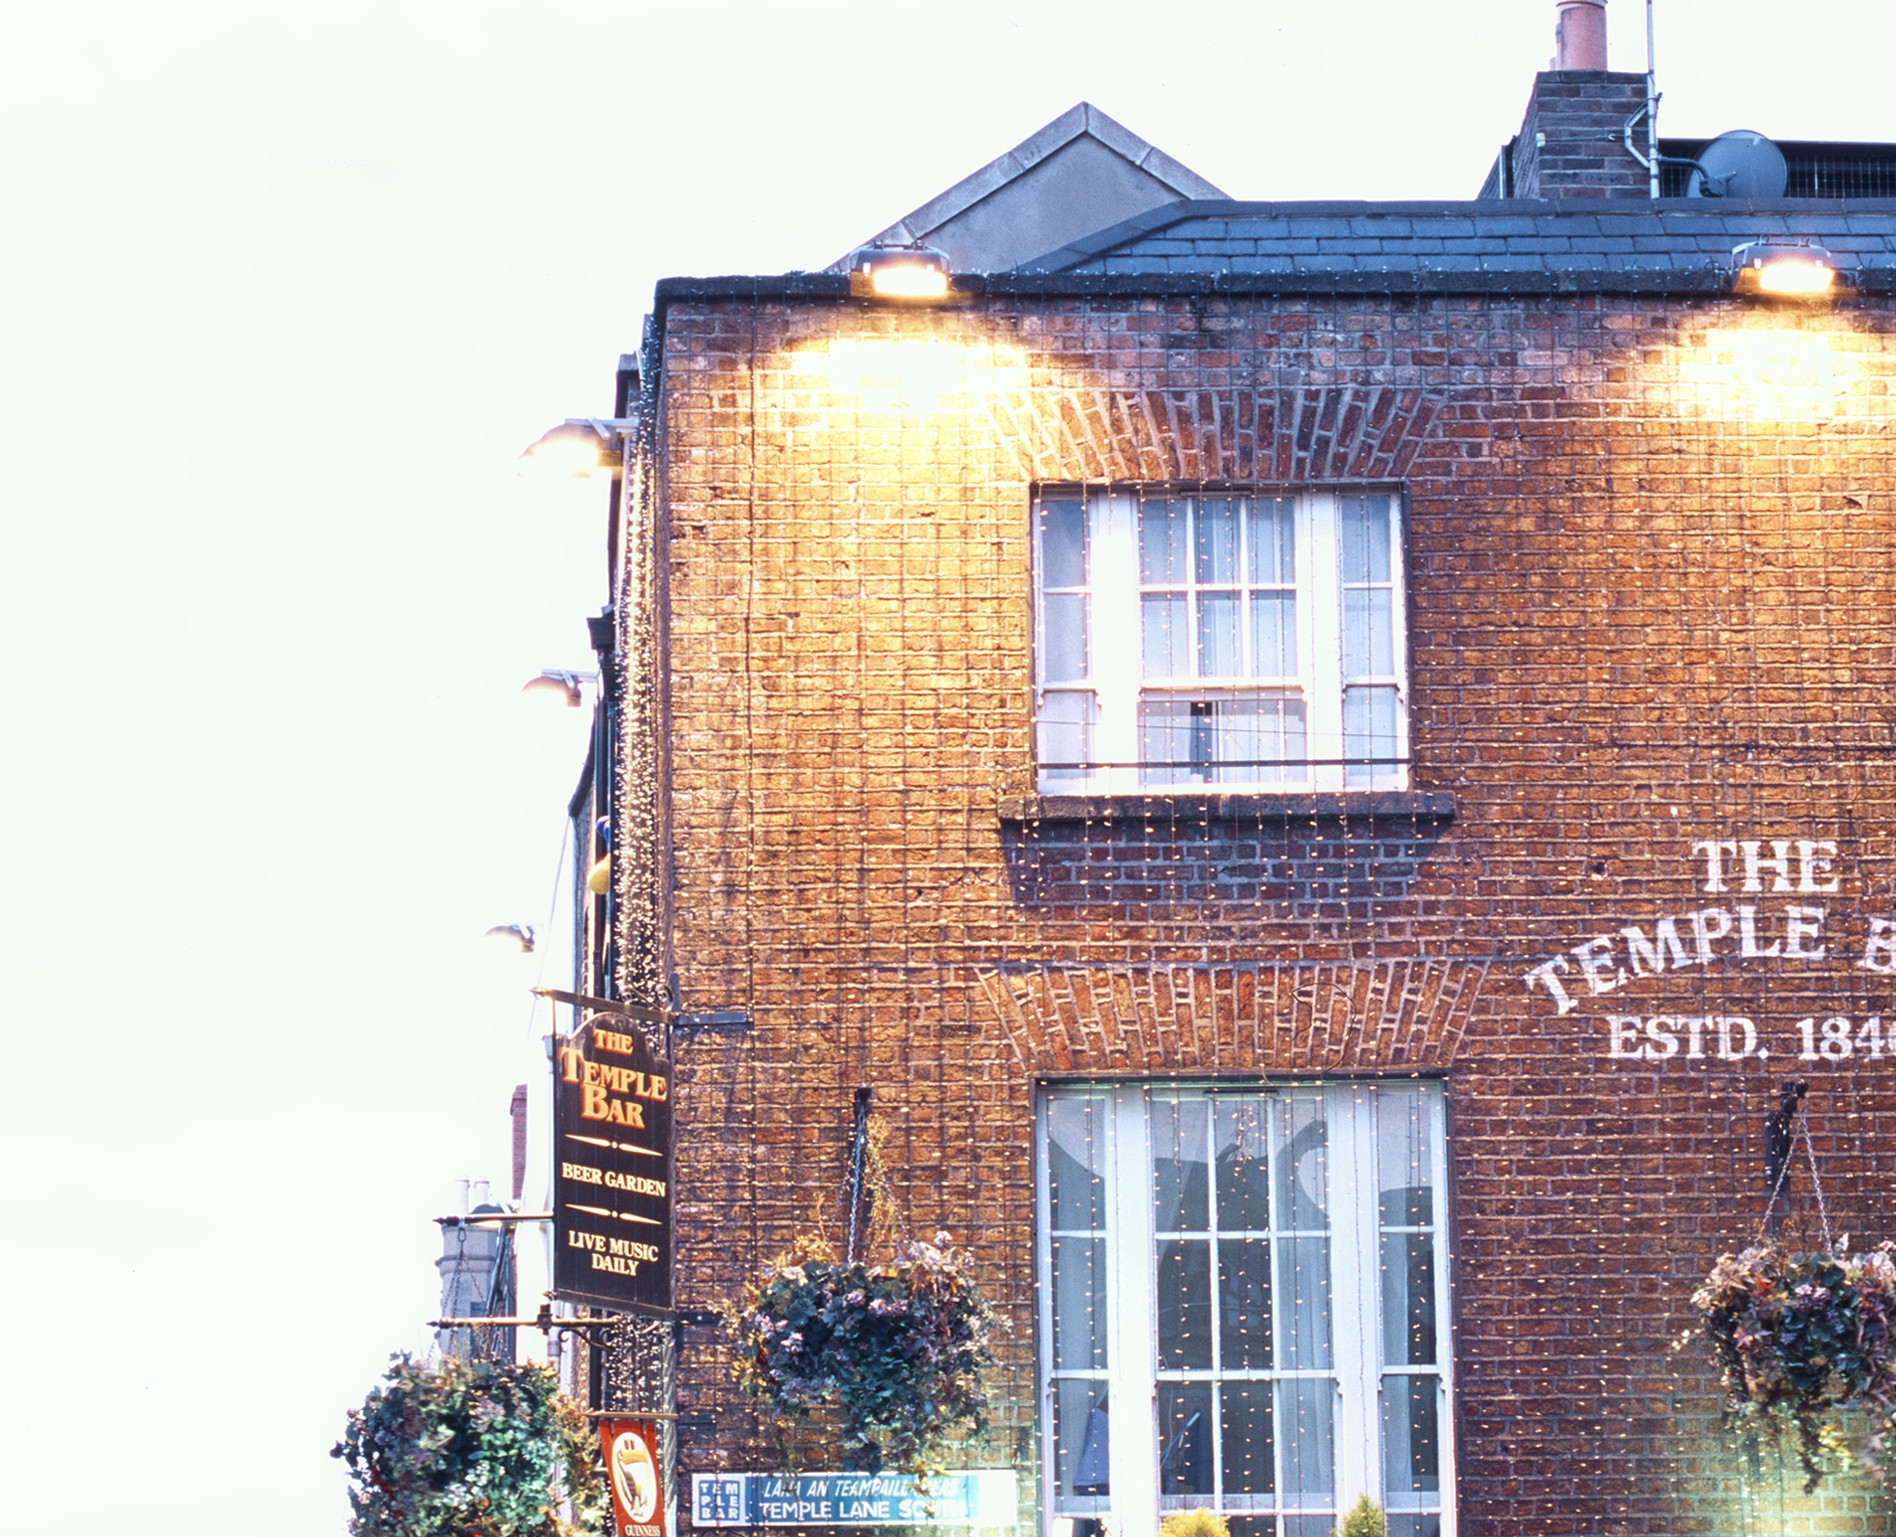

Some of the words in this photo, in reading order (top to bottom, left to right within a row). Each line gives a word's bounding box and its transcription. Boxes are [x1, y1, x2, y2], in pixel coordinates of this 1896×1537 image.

[1695, 840, 1838, 892] THE
[1522, 905, 1826, 1015] TEMPLE
[594, 1029, 633, 1055] THE
[560, 1047, 668, 1101] TEMPLE
[581, 1082, 646, 1130] BAR
[562, 1162, 602, 1185] BEER
[605, 1171, 667, 1197] GARDEN
[569, 1230, 606, 1253] LIVE
[609, 1238, 659, 1262] MUSIC
[591, 1253, 639, 1276] DAILY
[807, 1480, 829, 1497] AN
[702, 1507, 740, 1519] BAR
[759, 1502, 832, 1519] TEMPLE
[839, 1501, 891, 1519] LANE
[625, 1524, 662, 1537] GUINNESS
